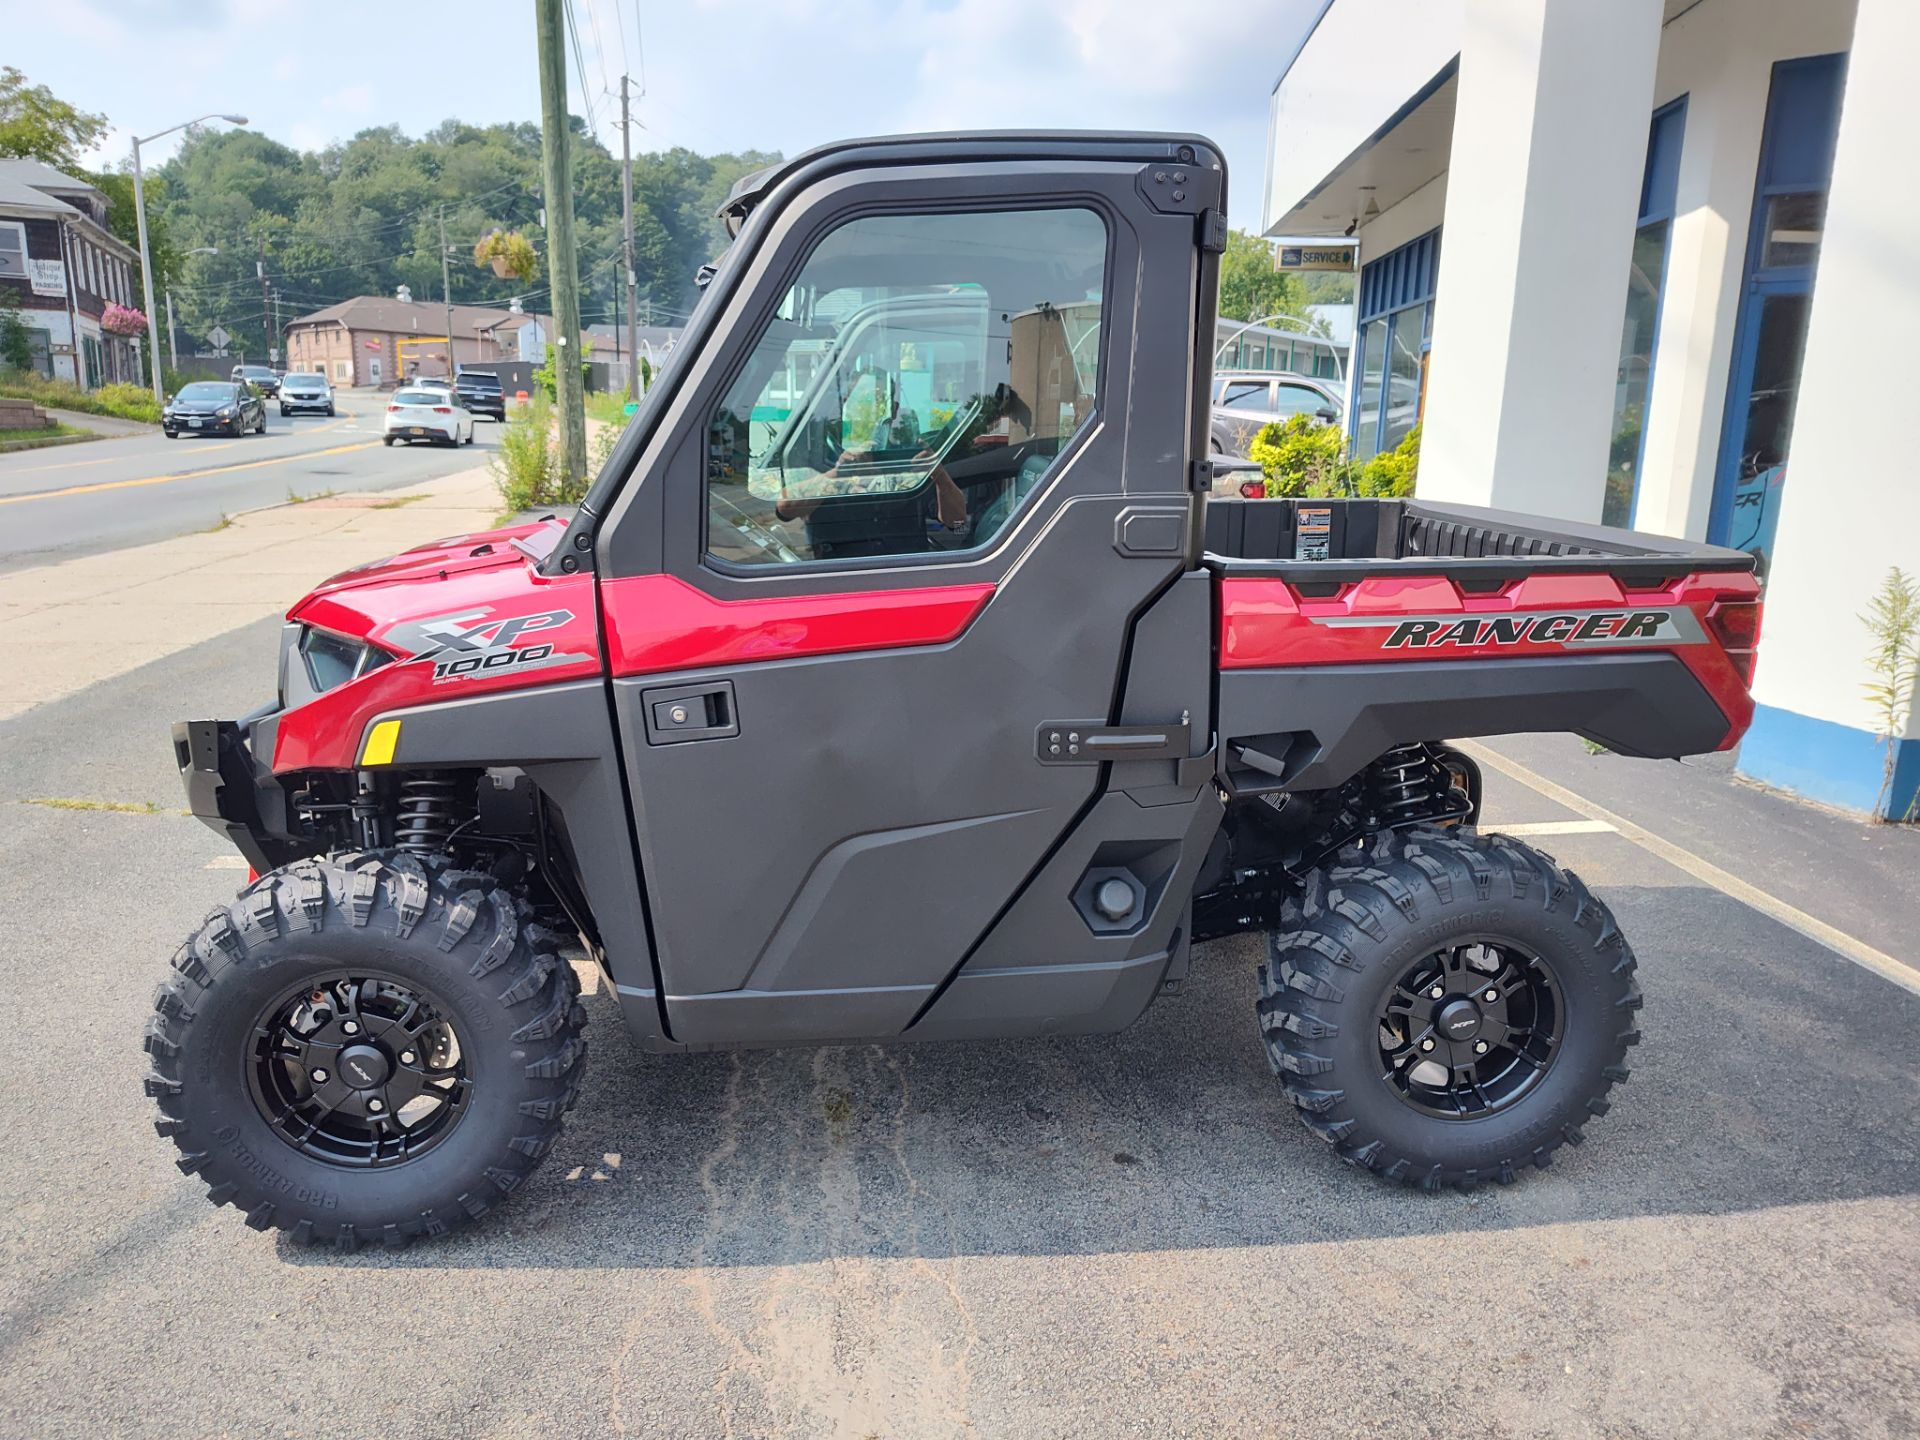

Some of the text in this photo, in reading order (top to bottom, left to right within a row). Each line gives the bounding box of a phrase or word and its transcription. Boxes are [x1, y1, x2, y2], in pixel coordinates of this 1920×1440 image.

[1303, 252, 1340, 264] SERVICE
[37, 270, 59, 282] Shop
[405, 609, 575, 664] XP
[1381, 611, 1671, 649] RANGER
[433, 676, 461, 686] DUAL
[464, 665, 521, 681] OVERHEAD
[434, 644, 554, 679] 1000
[1450, 1019, 1476, 1030] XP
[231, 1141, 339, 1210] PRO ARMOR
